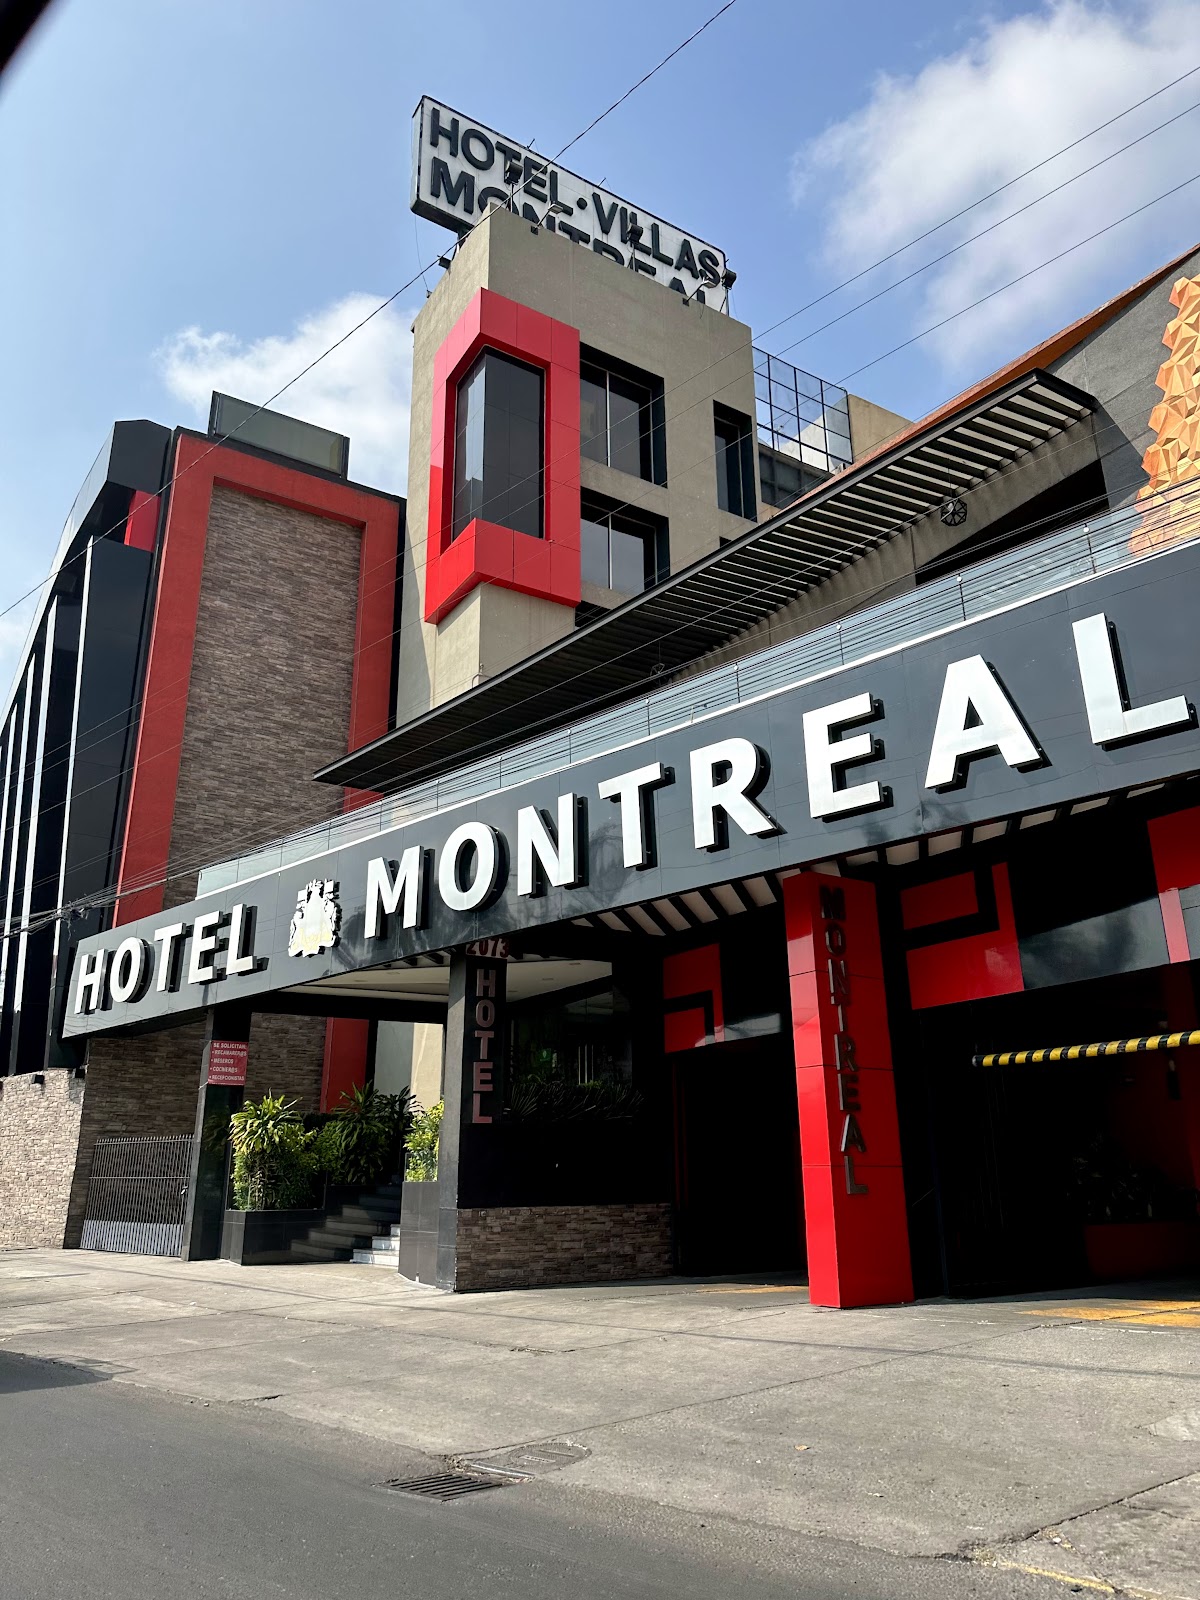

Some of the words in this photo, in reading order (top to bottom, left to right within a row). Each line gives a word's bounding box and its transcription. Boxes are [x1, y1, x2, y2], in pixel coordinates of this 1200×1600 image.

[430, 107, 574, 216] HOTEL
[592, 192, 721, 287] VILLAS
[74, 903, 260, 1015] HOTEL
[363, 612, 1196, 940] MONTREAL
[466, 937, 509, 958] 2073
[472, 968, 496, 1124] HOTEL
[820, 884, 868, 1195] MONTREAL
